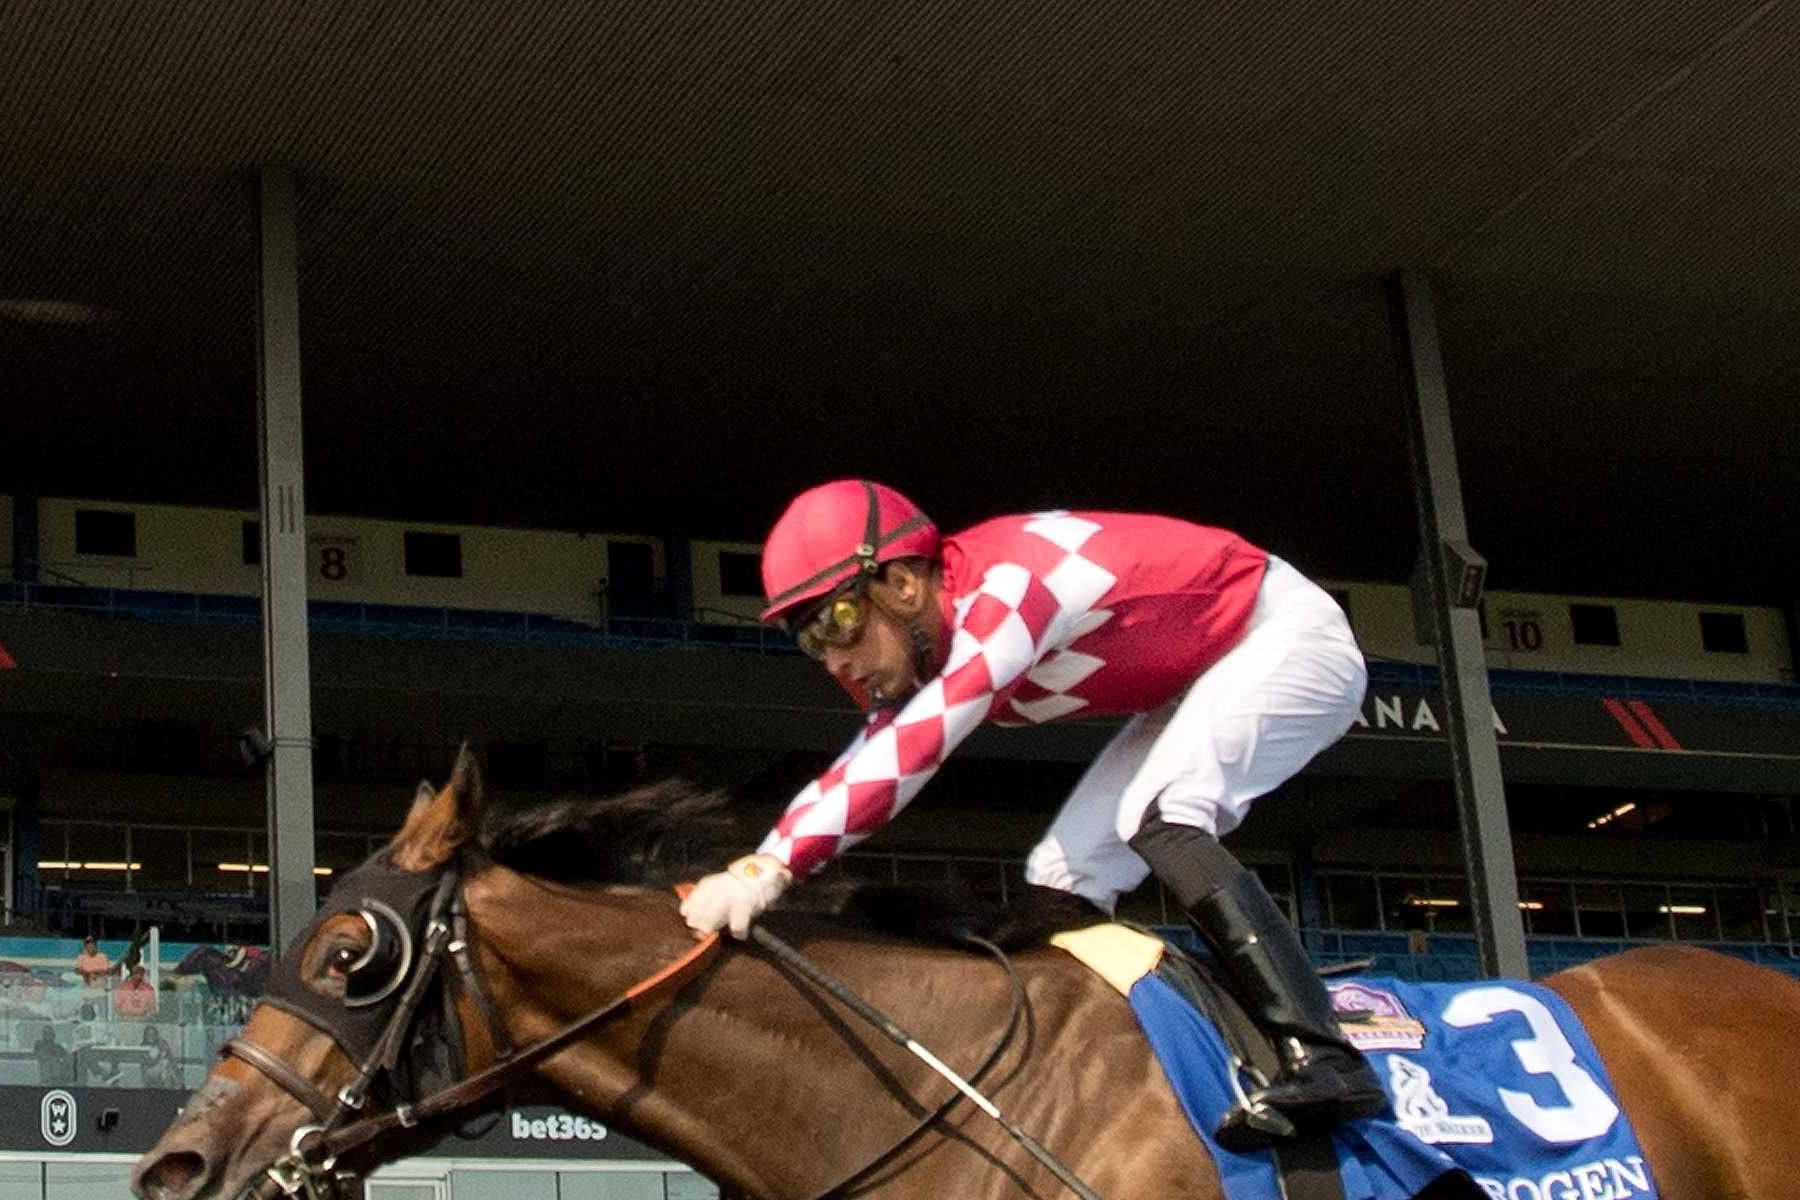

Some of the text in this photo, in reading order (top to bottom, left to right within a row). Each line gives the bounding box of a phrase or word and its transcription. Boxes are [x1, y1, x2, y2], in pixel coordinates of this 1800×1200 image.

[320, 547, 347, 581] 8
[1502, 621, 1542, 652] 10
[1441, 986, 1620, 1145] 3
[512, 1112, 607, 1140] bet365
